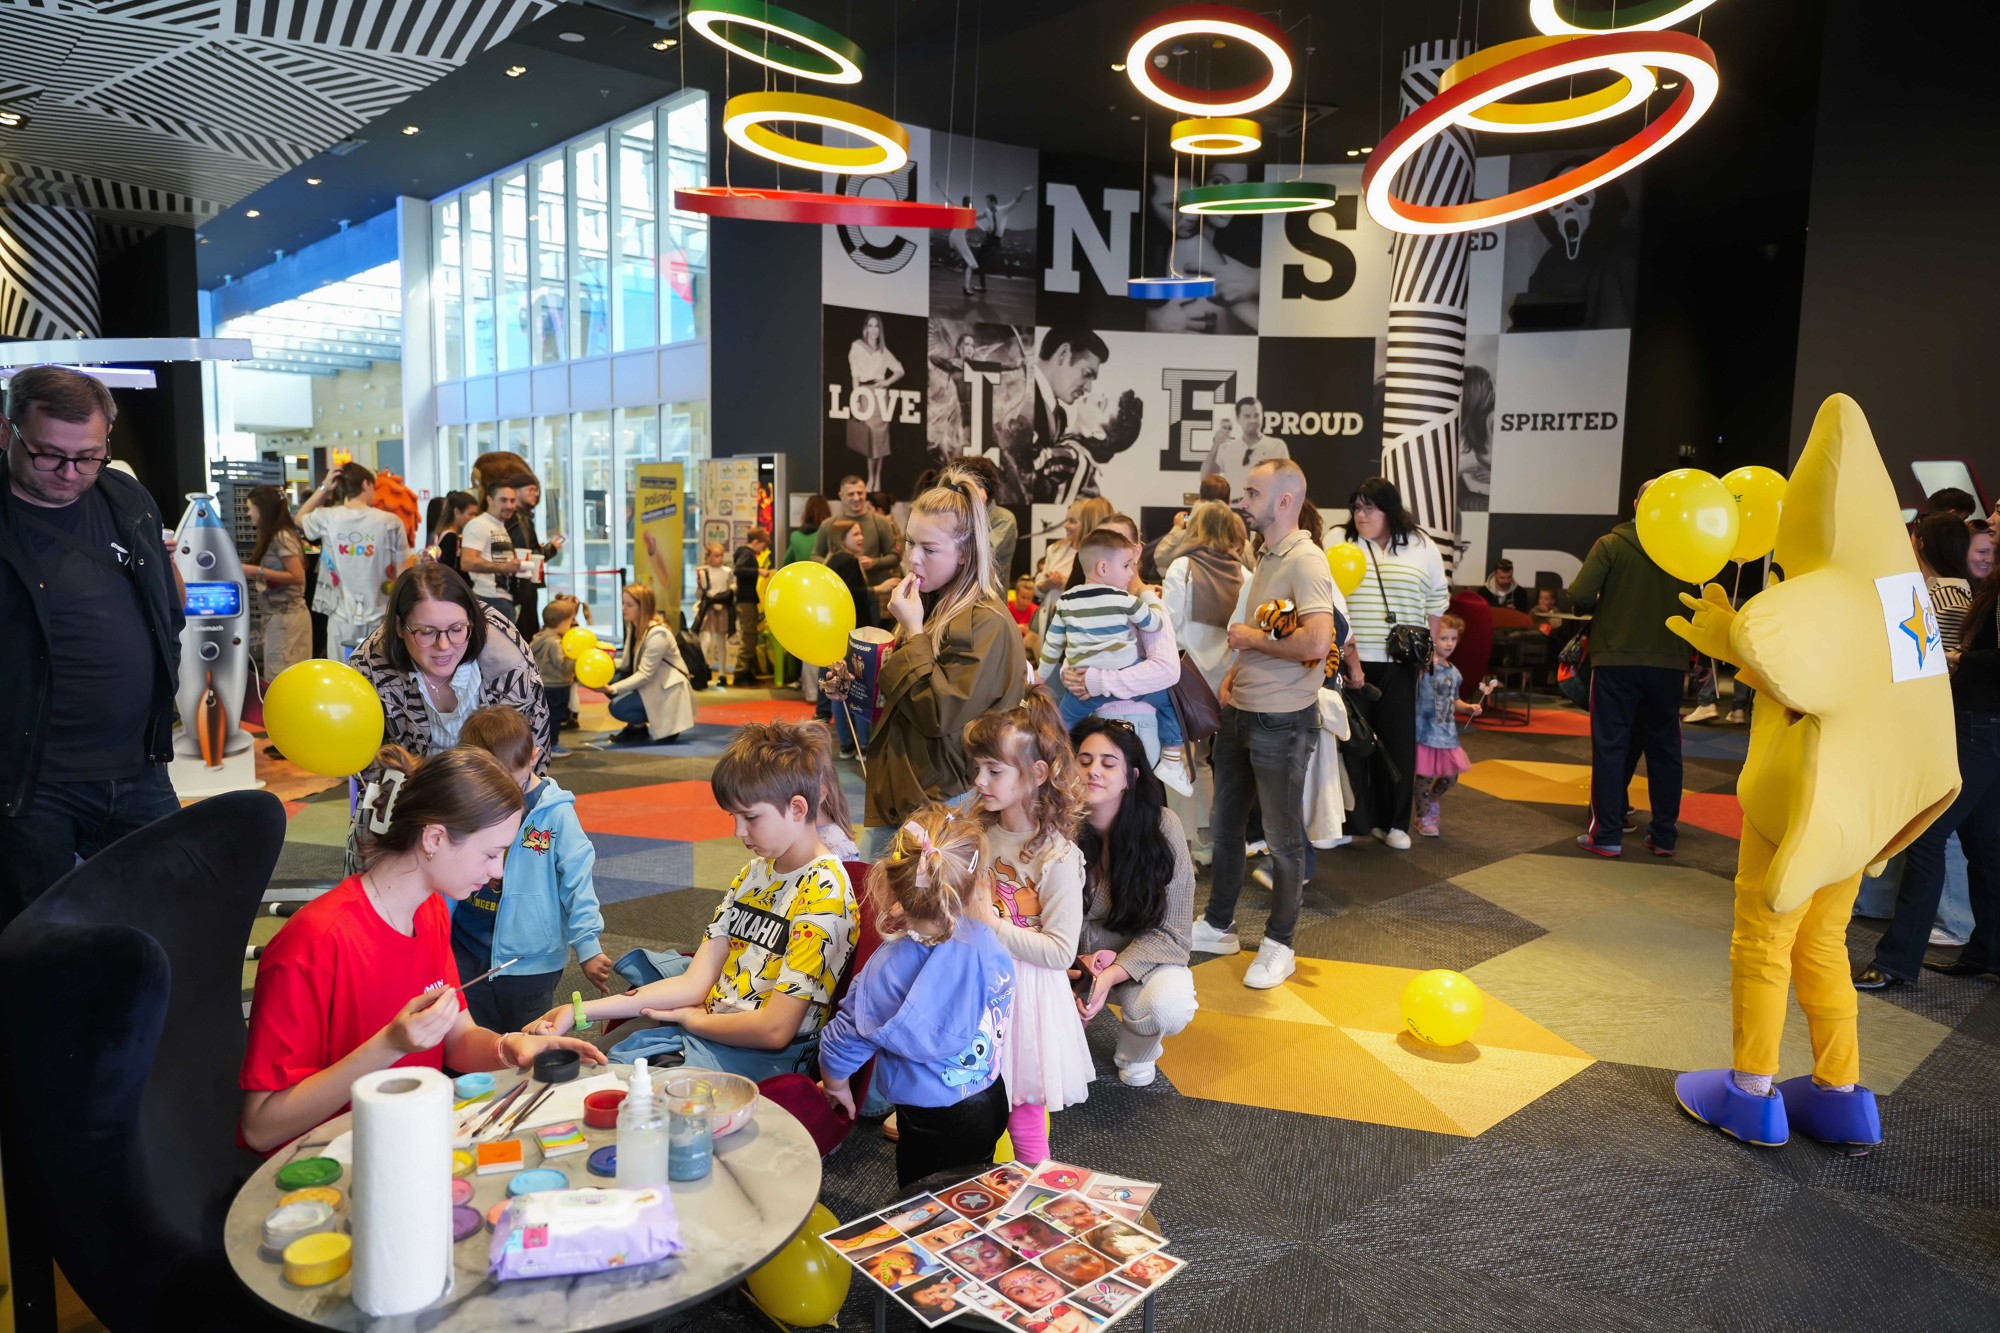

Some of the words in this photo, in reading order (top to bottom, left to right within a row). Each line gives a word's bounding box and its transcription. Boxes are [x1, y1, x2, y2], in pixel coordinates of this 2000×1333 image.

[835, 159, 918, 274] C
[1044, 182, 1140, 297] N
[1282, 195, 1358, 301] S
[829, 384, 921, 424] LOVE
[1160, 368, 1237, 471] E
[1263, 411, 1364, 436] PROUD
[1500, 411, 1618, 432] SPIRITED
